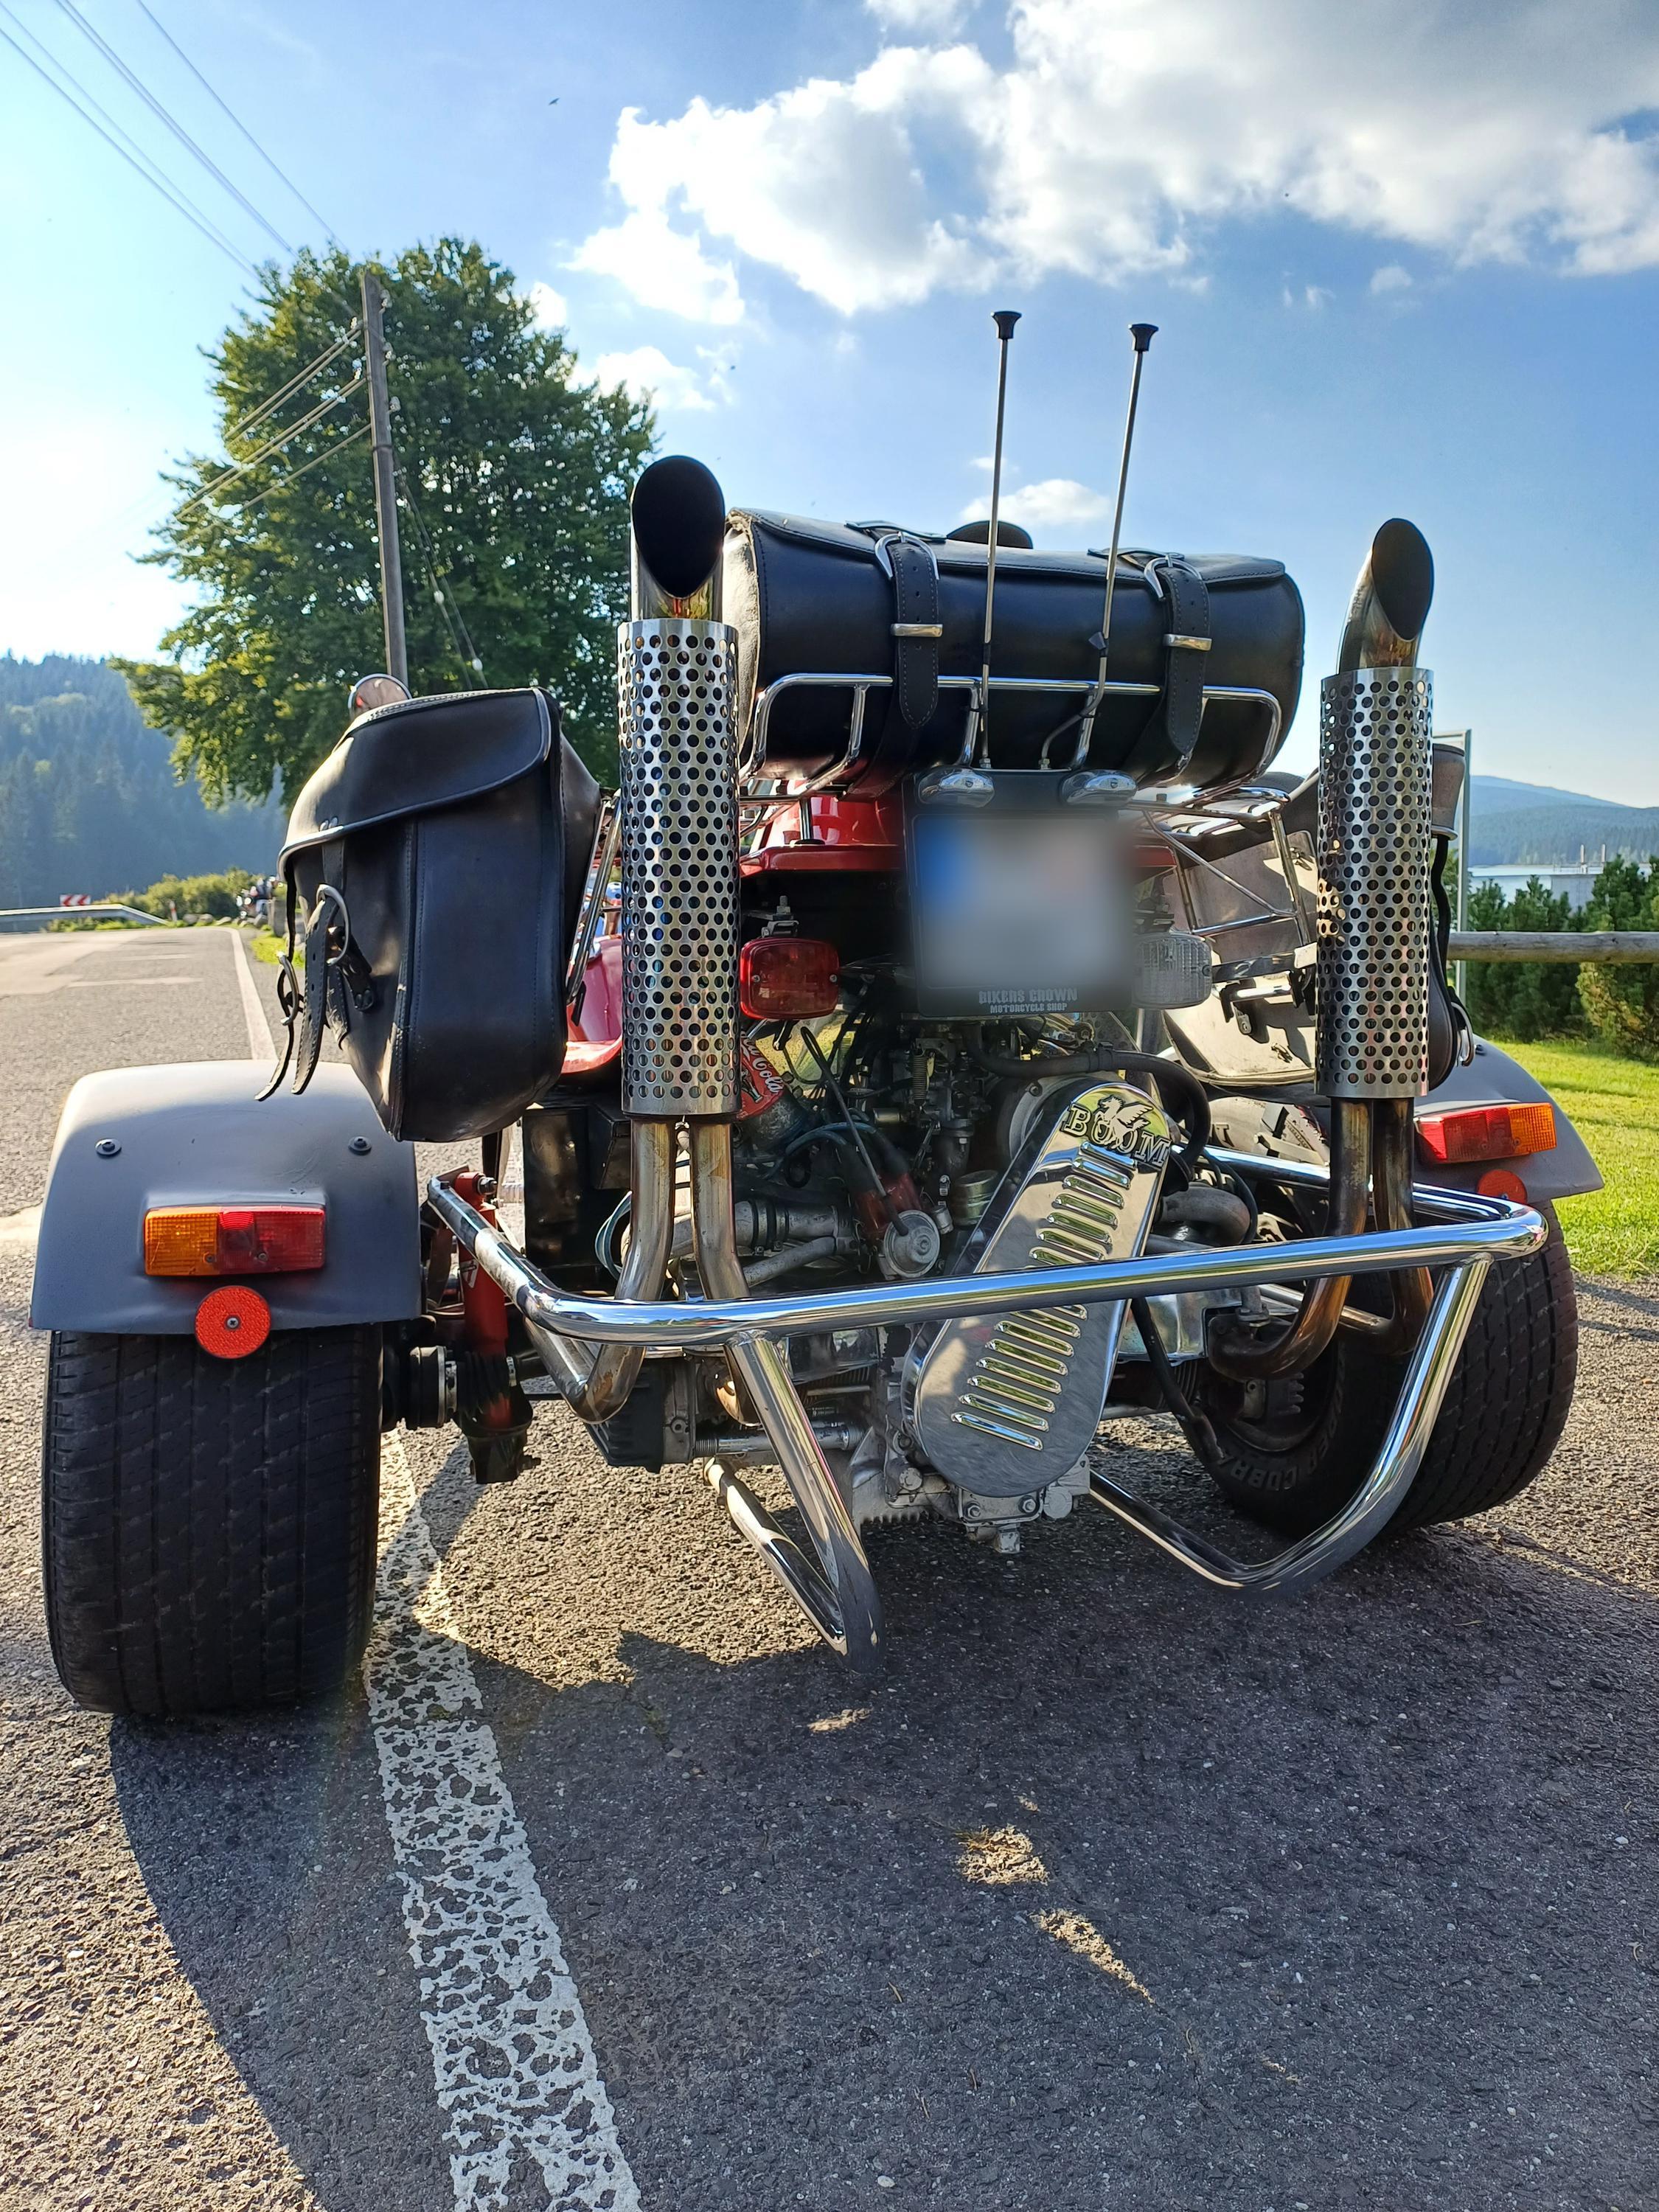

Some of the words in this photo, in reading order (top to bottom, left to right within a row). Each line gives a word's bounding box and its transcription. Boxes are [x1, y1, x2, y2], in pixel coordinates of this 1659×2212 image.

[978, 989, 1025, 1004] BIKERS
[1029, 987, 1078, 1003] CROWN
[990, 1004, 1045, 1014] MOTORCYCLE
[1047, 1002, 1068, 1012] SHOP
